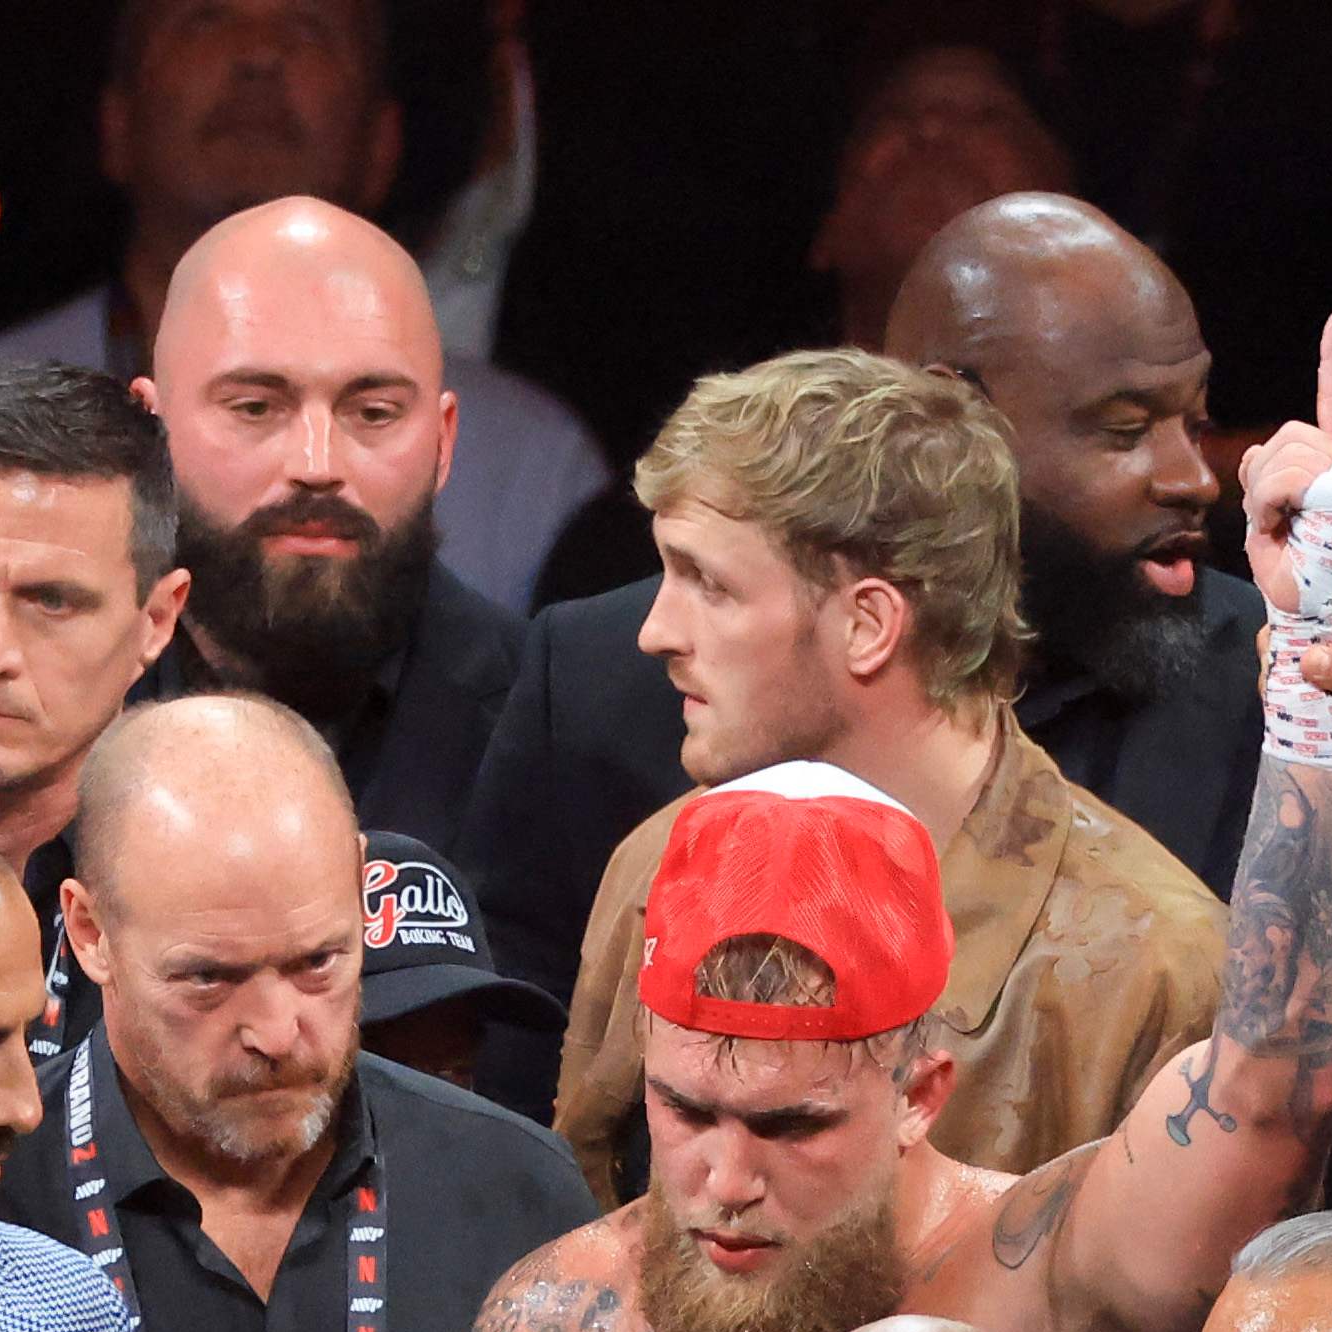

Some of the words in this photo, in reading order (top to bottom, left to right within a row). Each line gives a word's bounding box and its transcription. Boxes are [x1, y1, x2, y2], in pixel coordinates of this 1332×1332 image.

[364, 860, 468, 949] Gallo
[398, 927, 447, 945] BOXING
[446, 931, 476, 953] TEAM
